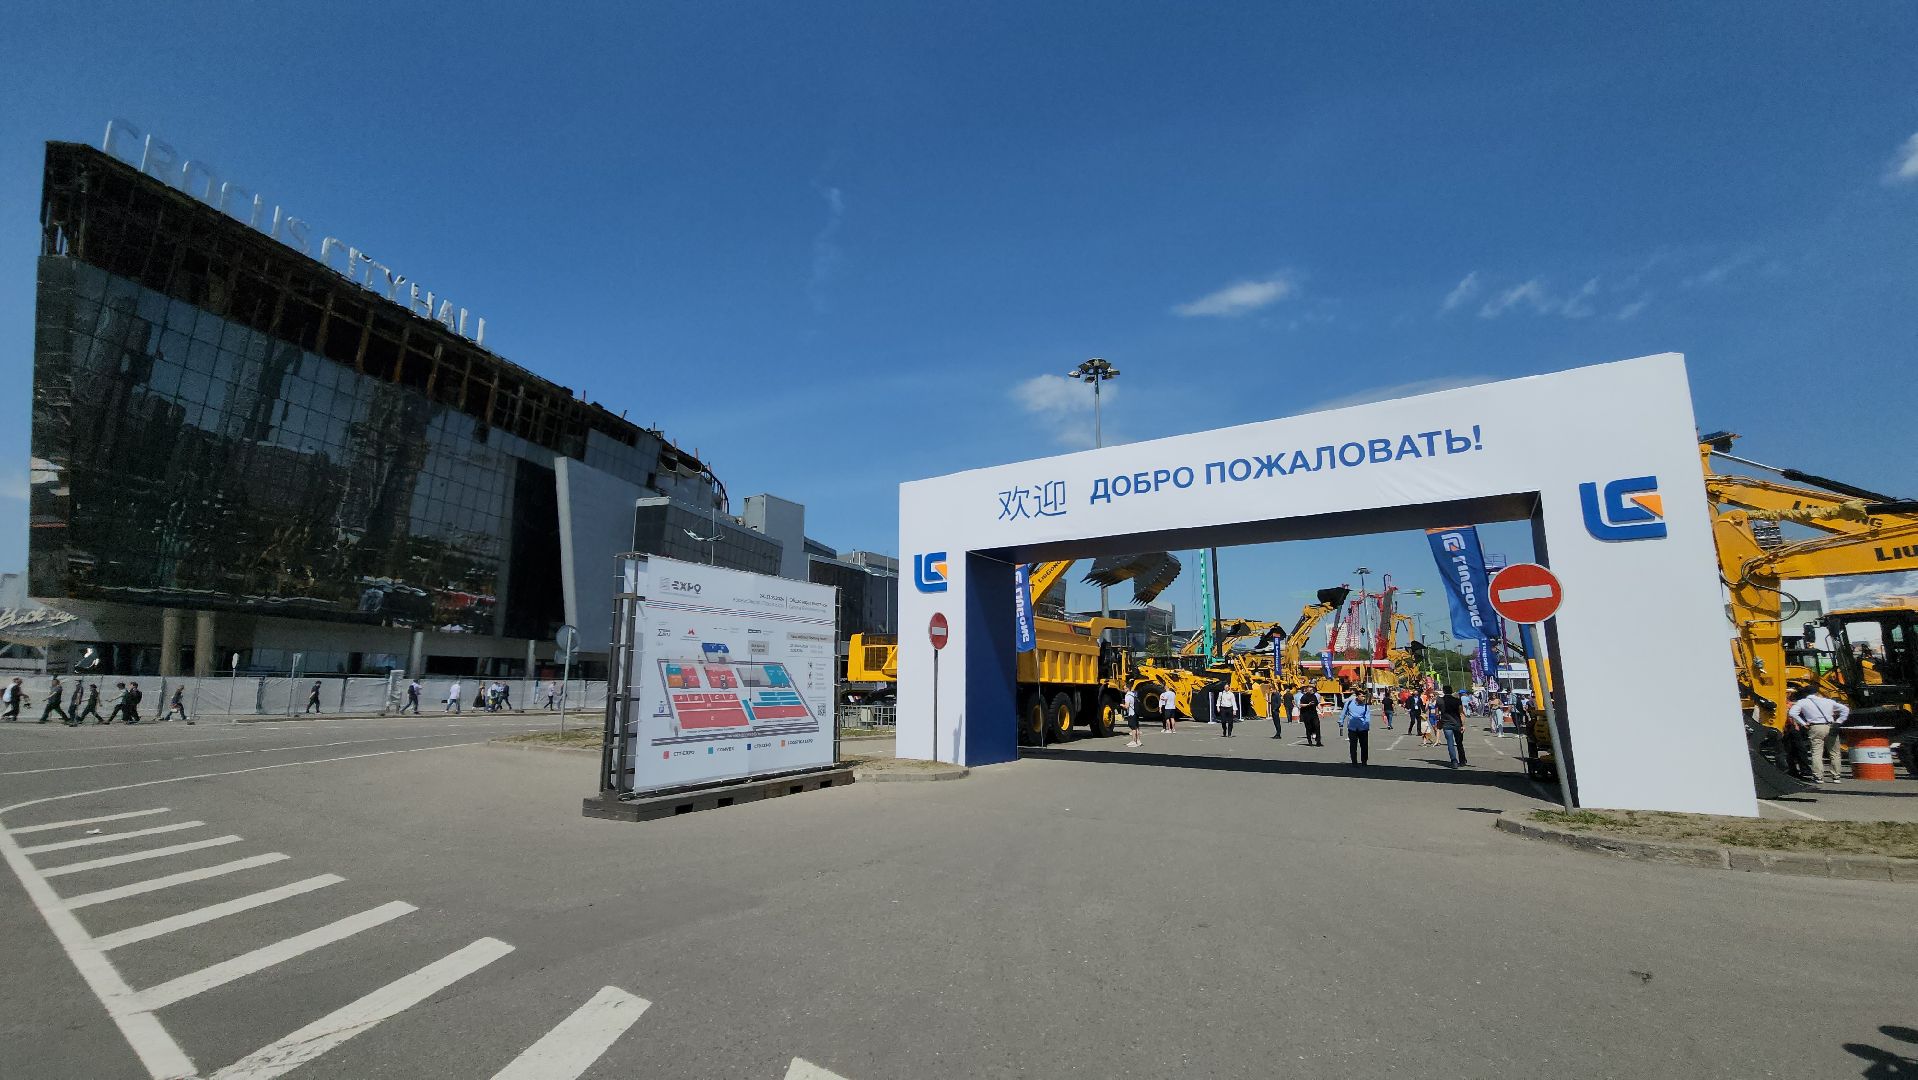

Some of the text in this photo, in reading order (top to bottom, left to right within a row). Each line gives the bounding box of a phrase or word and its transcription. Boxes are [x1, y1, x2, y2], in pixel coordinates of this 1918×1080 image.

[1089, 424, 1484, 506] ДОБРО ПОЖАЛОВАТЬ!
[998, 479, 1068, 521] 欢迎
